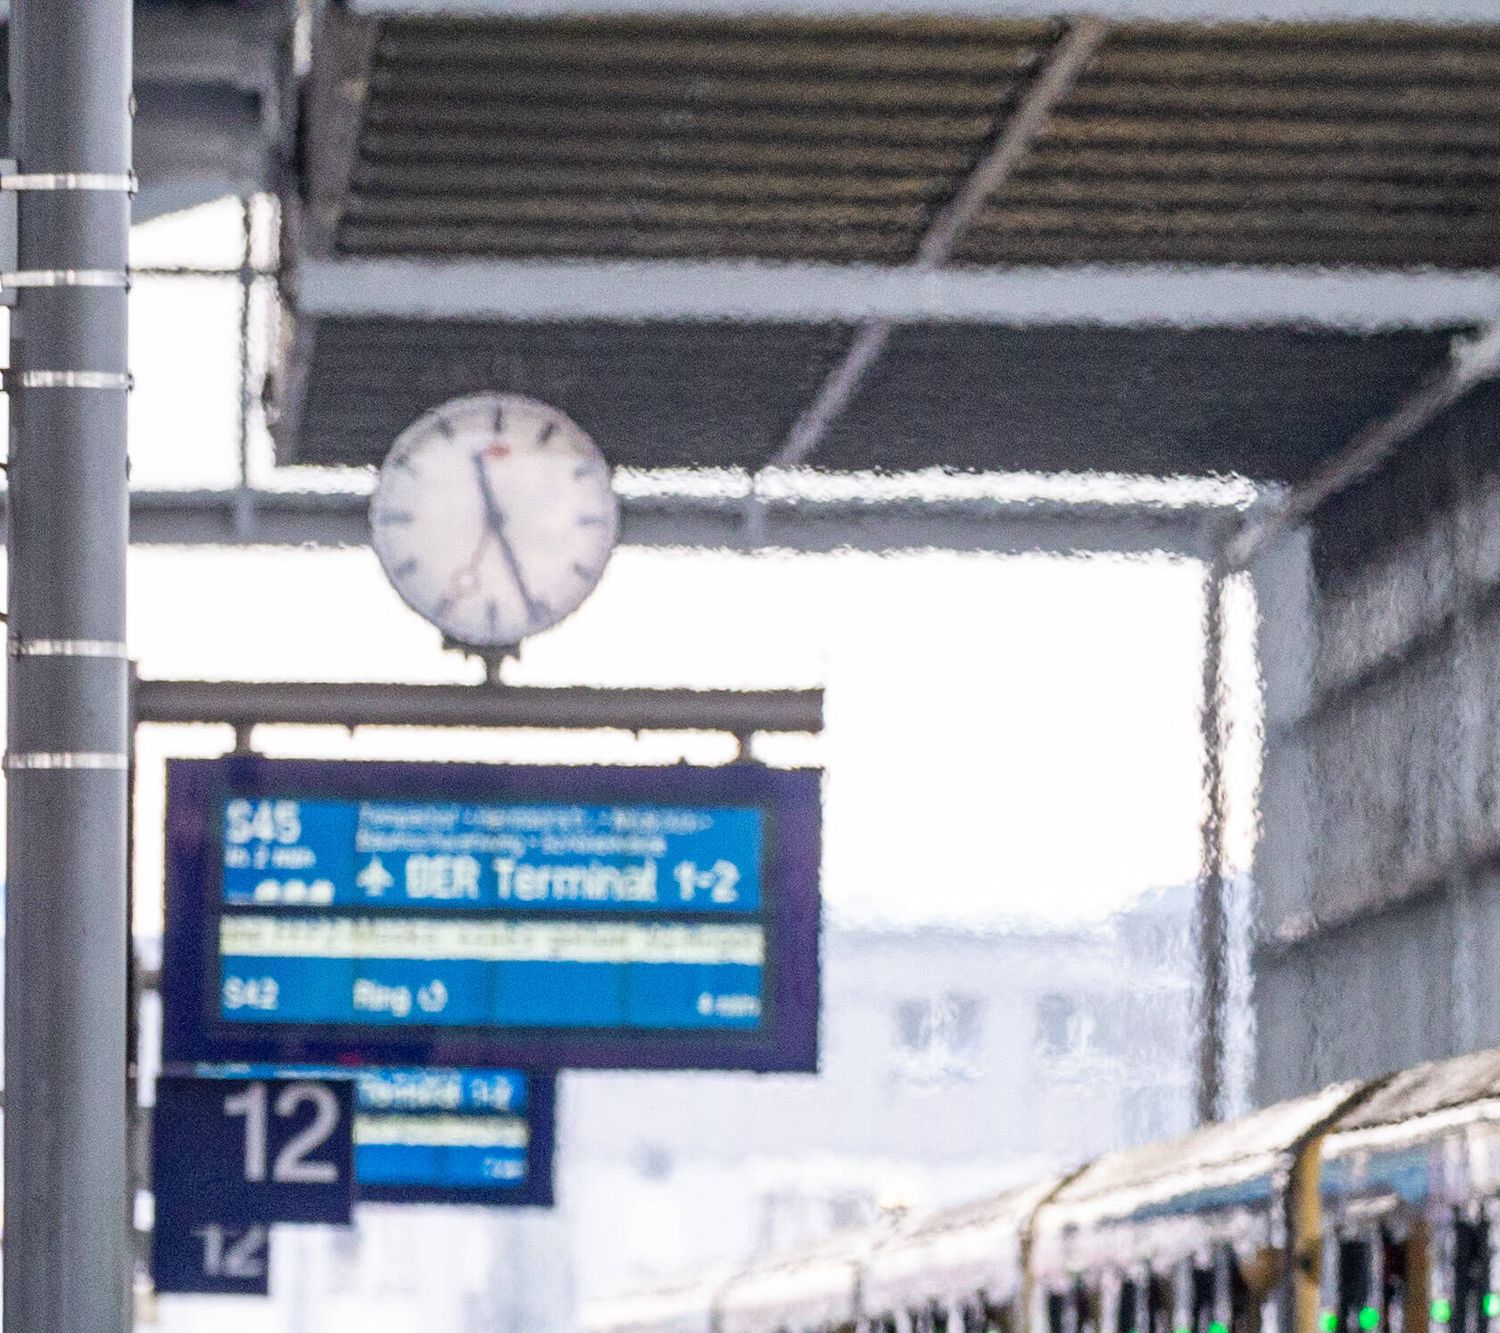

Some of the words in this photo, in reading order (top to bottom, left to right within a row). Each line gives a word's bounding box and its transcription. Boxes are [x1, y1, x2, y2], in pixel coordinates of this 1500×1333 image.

[227, 799, 300, 844] S45
[406, 855, 481, 900] BER
[494, 855, 657, 902] Terminal
[675, 858, 741, 903] 1-2
[224, 1080, 341, 1184] 12
